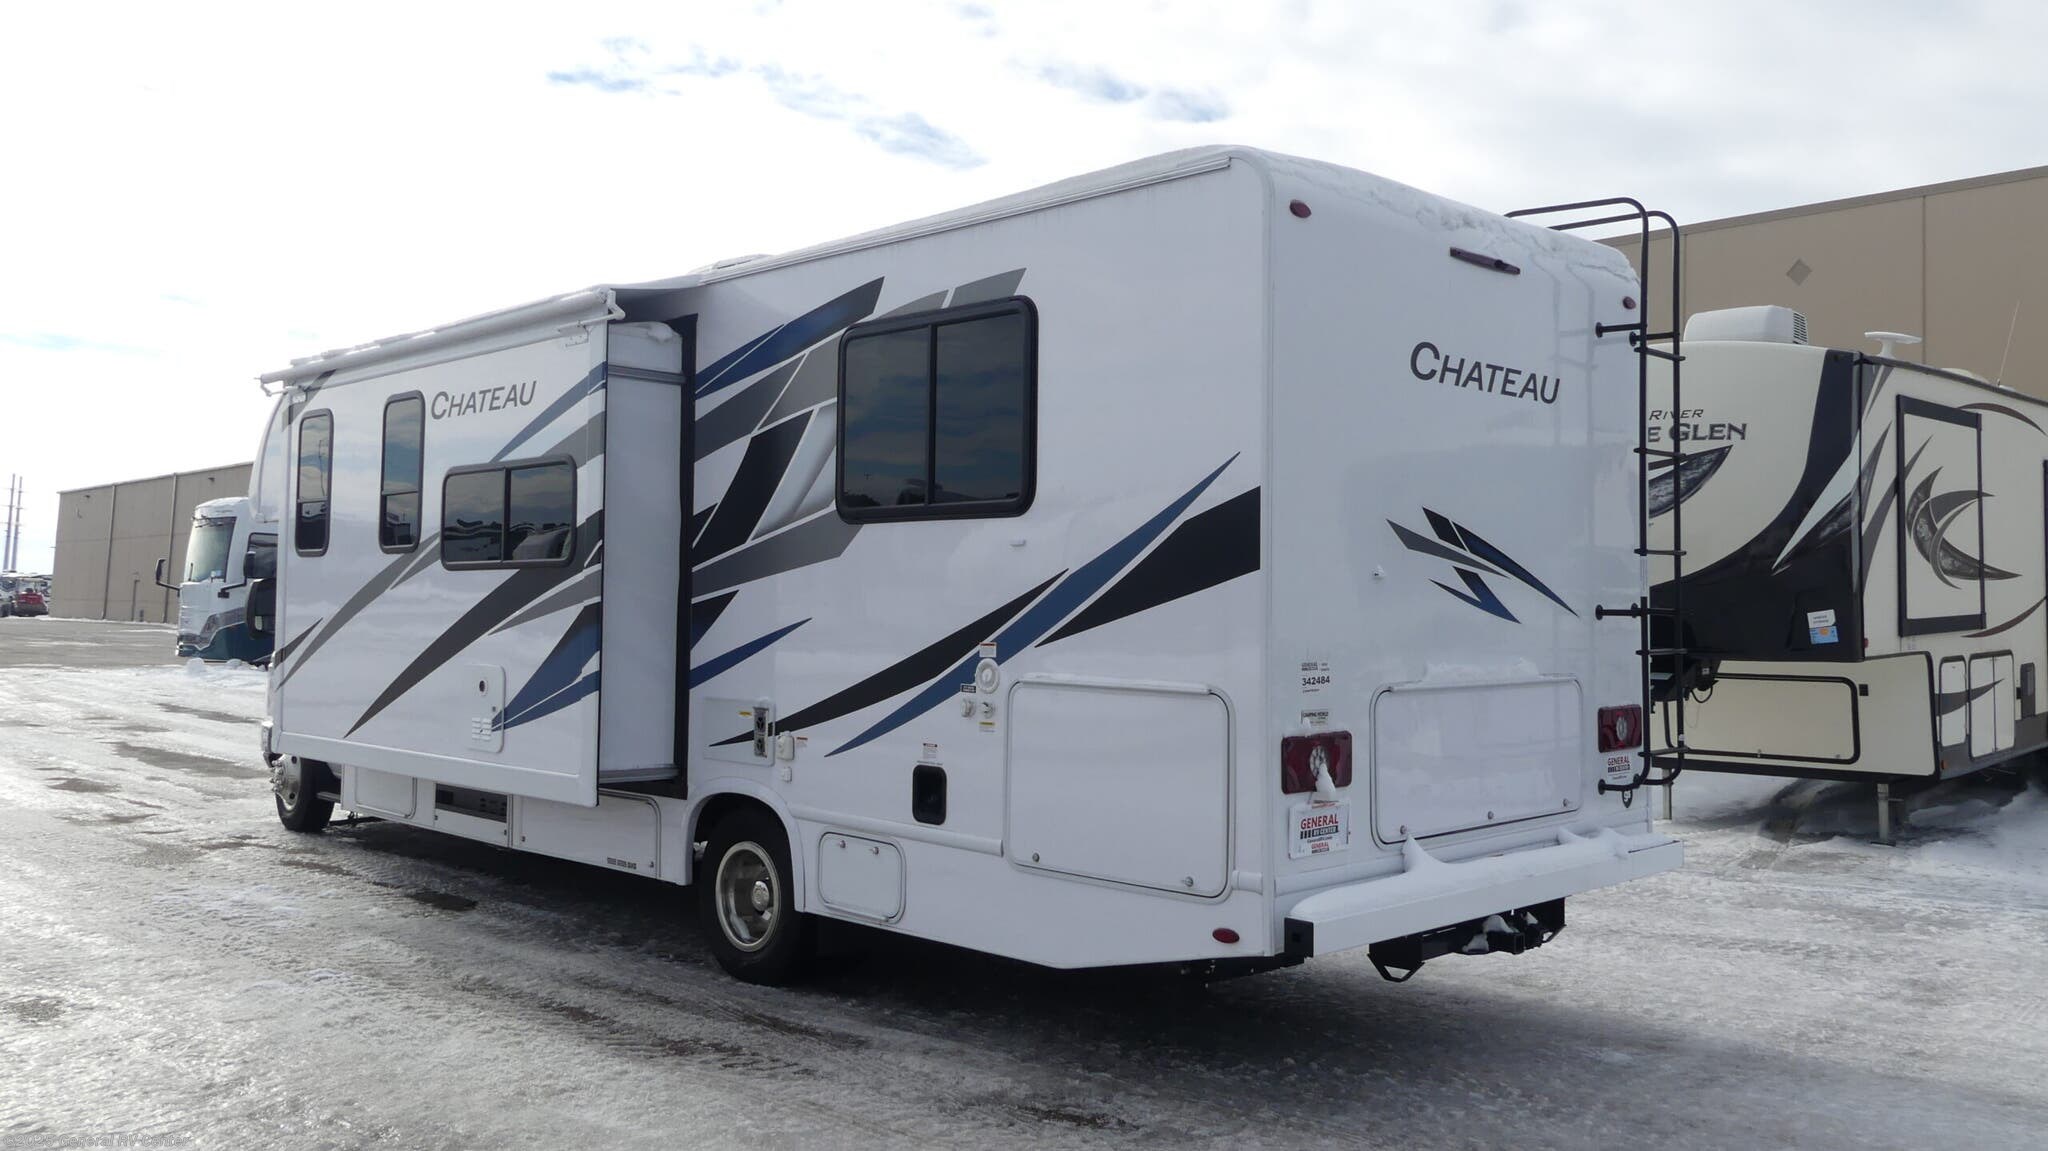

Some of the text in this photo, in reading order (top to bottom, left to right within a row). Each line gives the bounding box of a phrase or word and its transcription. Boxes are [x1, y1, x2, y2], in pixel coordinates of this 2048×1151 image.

[1410, 341, 1560, 404] CHATEAU
[431, 381, 536, 420] CHATEAU
[1669, 423, 1747, 441] GLEN
[1302, 675, 1330, 686] 342484
[1608, 756, 1630, 766] GENERAL
[1301, 814, 1338, 829] GENERAL
